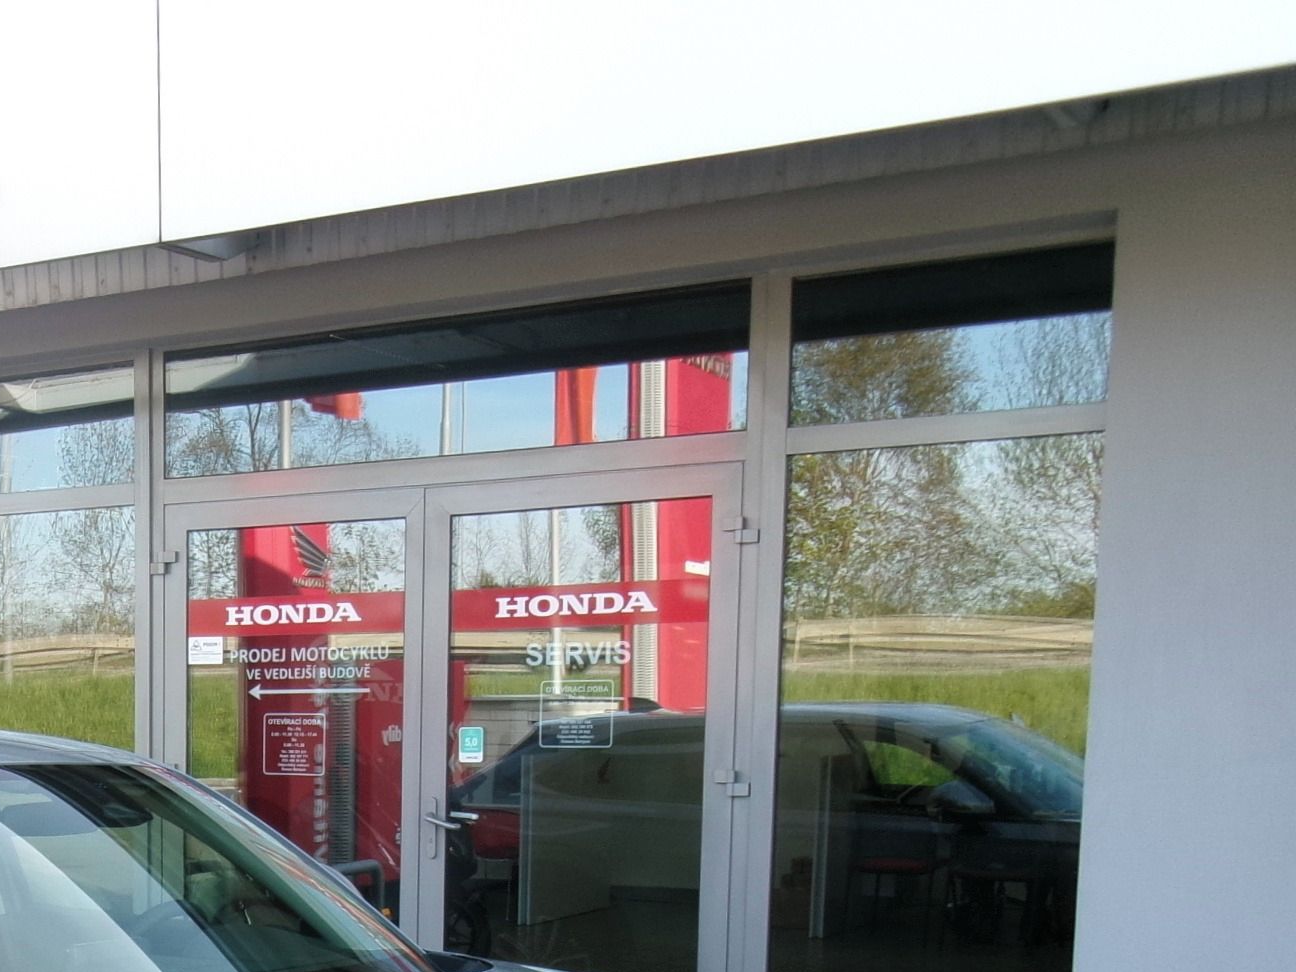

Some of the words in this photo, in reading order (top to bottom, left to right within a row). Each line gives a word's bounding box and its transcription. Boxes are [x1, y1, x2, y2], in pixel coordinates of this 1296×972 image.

[225, 602, 362, 626] HONDA
[495, 591, 658, 618] HONDA
[229, 647, 286, 664] PRODEJ
[290, 642, 390, 662] MOTOCYKLŮ
[525, 640, 632, 667] SERVIS
[246, 667, 261, 681] VE
[264, 664, 317, 681] VEDLEJŠÍ
[319, 663, 372, 680] BUDOVĚ
